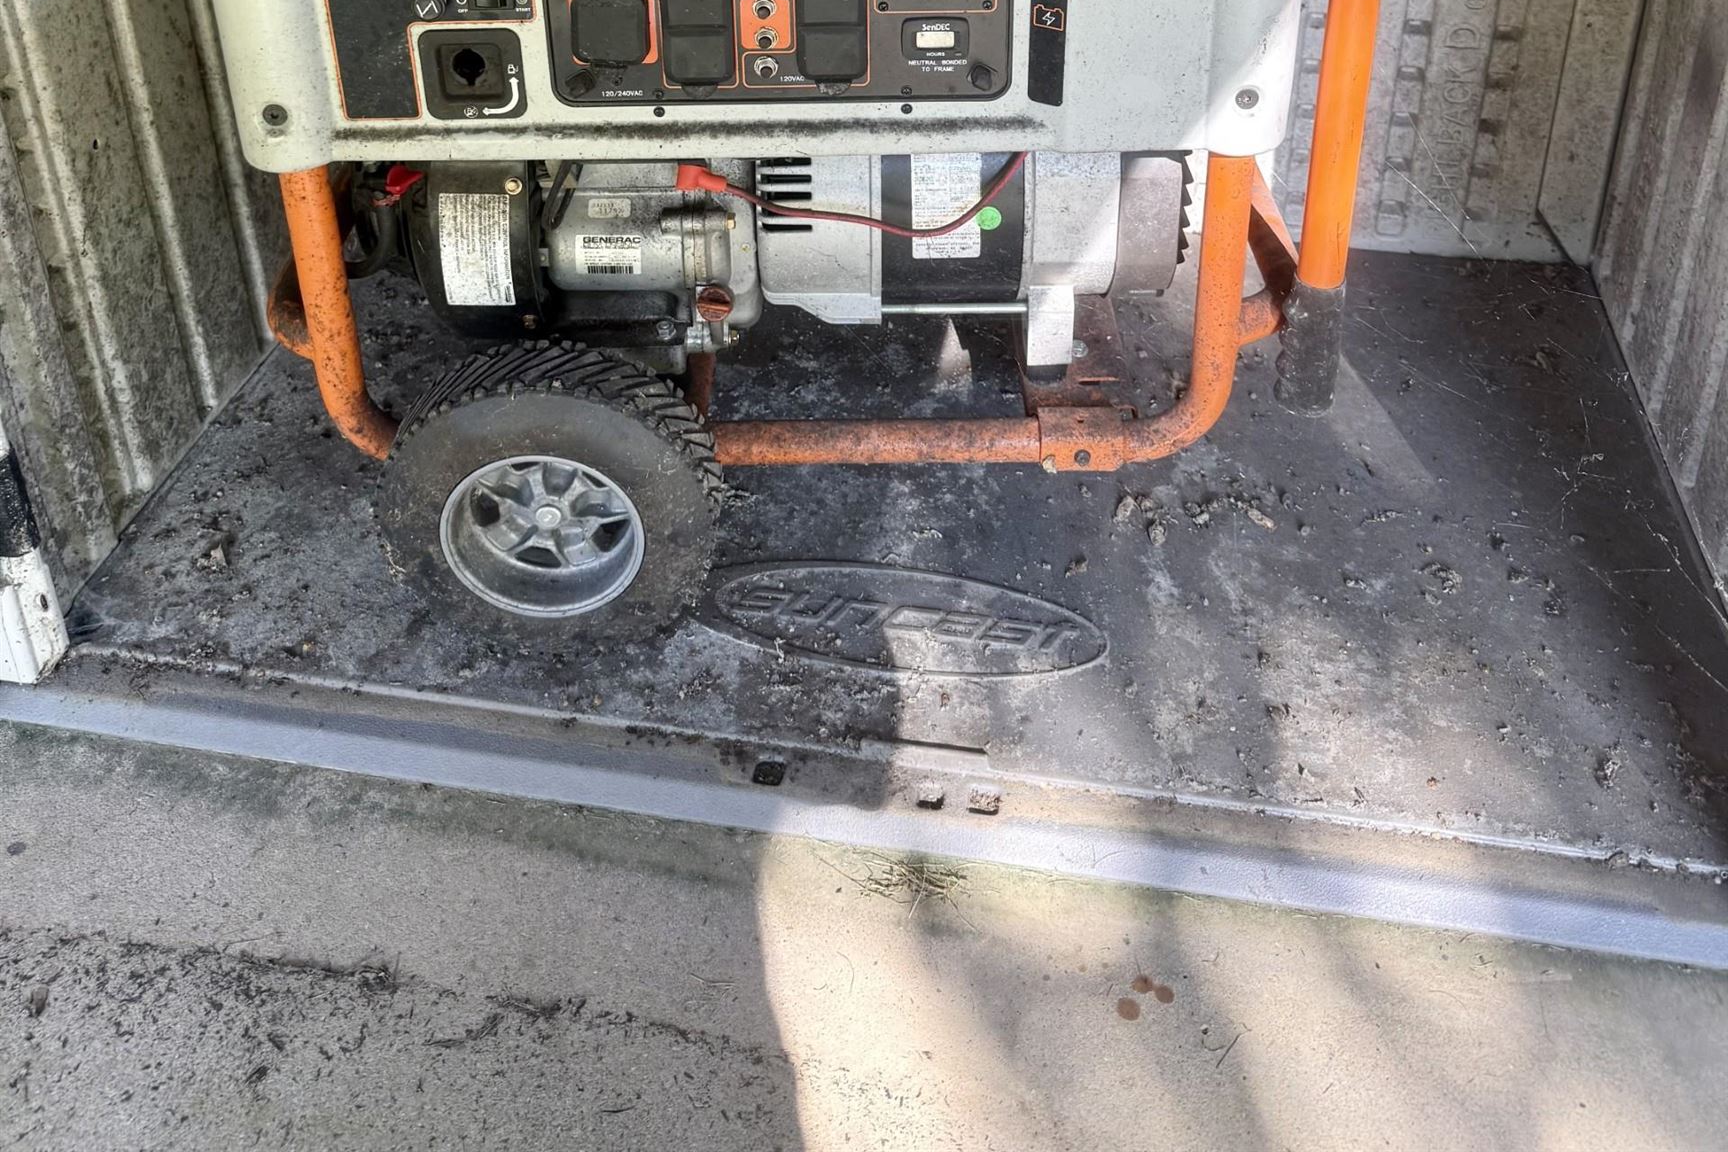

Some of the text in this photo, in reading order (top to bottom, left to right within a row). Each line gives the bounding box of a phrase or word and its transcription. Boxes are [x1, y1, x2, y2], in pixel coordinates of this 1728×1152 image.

[921, 23, 950, 31] SenDEC
[601, 89, 643, 97] 120/240VAC
[1434, 64, 1477, 145] BACK
[582, 236, 641, 244] GENERAC
